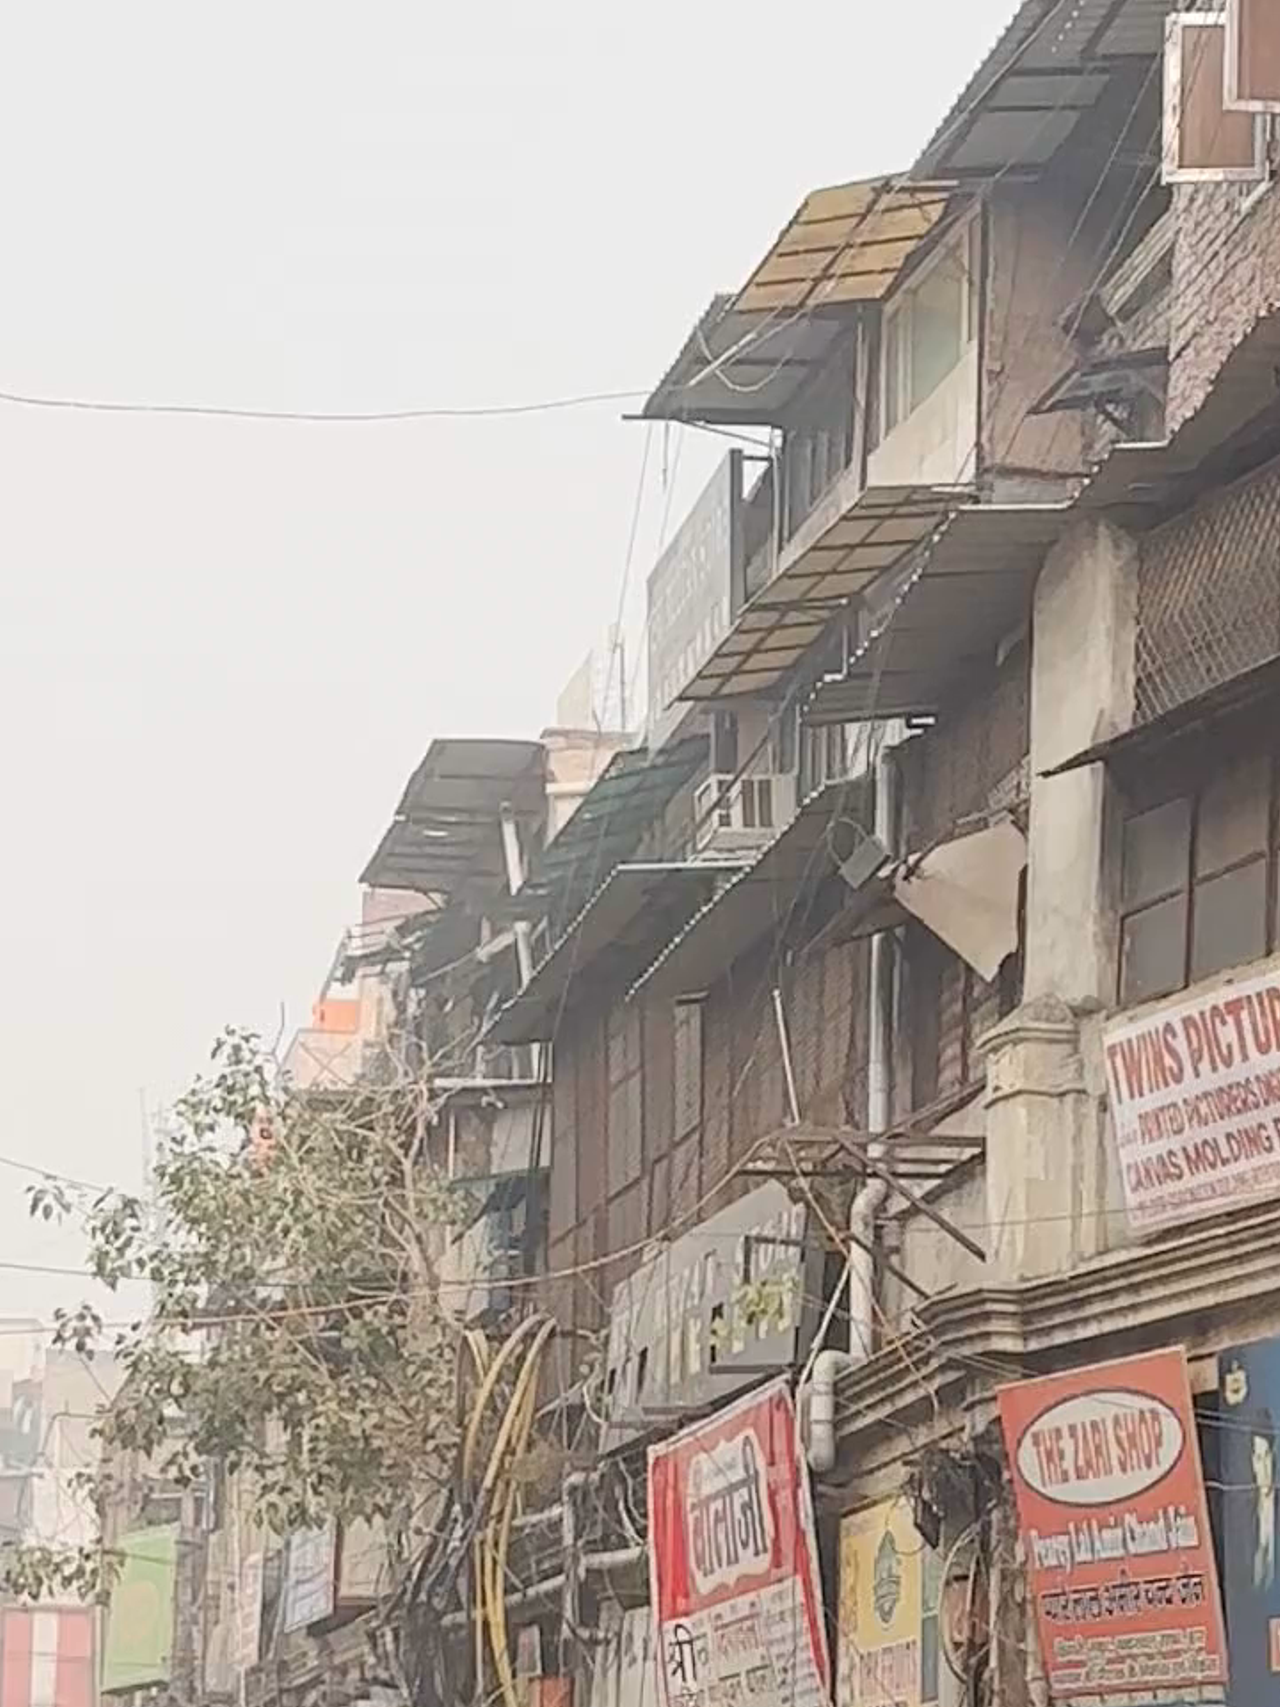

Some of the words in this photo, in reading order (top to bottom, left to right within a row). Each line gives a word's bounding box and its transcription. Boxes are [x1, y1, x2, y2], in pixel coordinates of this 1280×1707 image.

[1107, 1021, 1184, 1105] TWINS
[1181, 1122, 1274, 1178] MOLDING
[1031, 1424, 1069, 1489] THE
[1069, 1416, 1113, 1481] ZARI
[1114, 1407, 1164, 1475] SHOP
